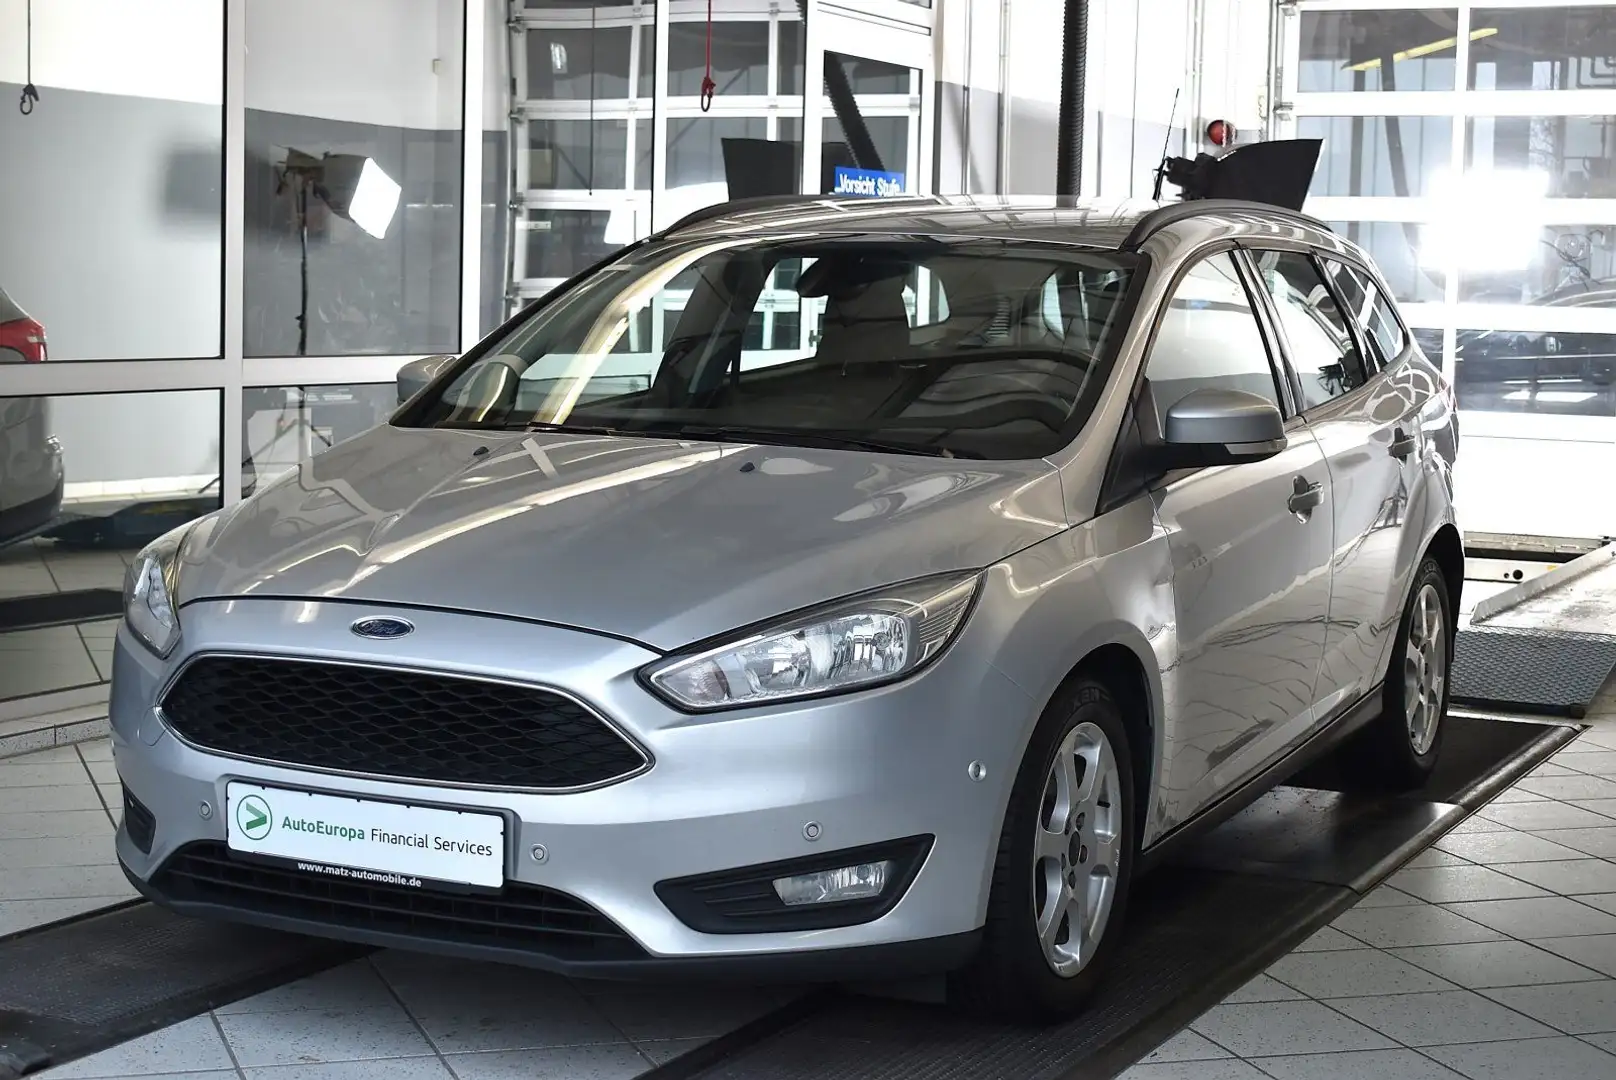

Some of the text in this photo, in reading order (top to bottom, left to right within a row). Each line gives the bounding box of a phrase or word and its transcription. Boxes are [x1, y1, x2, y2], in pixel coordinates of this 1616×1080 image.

[839, 173, 875, 195] Vorsicht
[282, 816, 493, 856] AutoEuropa Financial Services
[297, 862, 422, 887] www.matz-automobile.de
